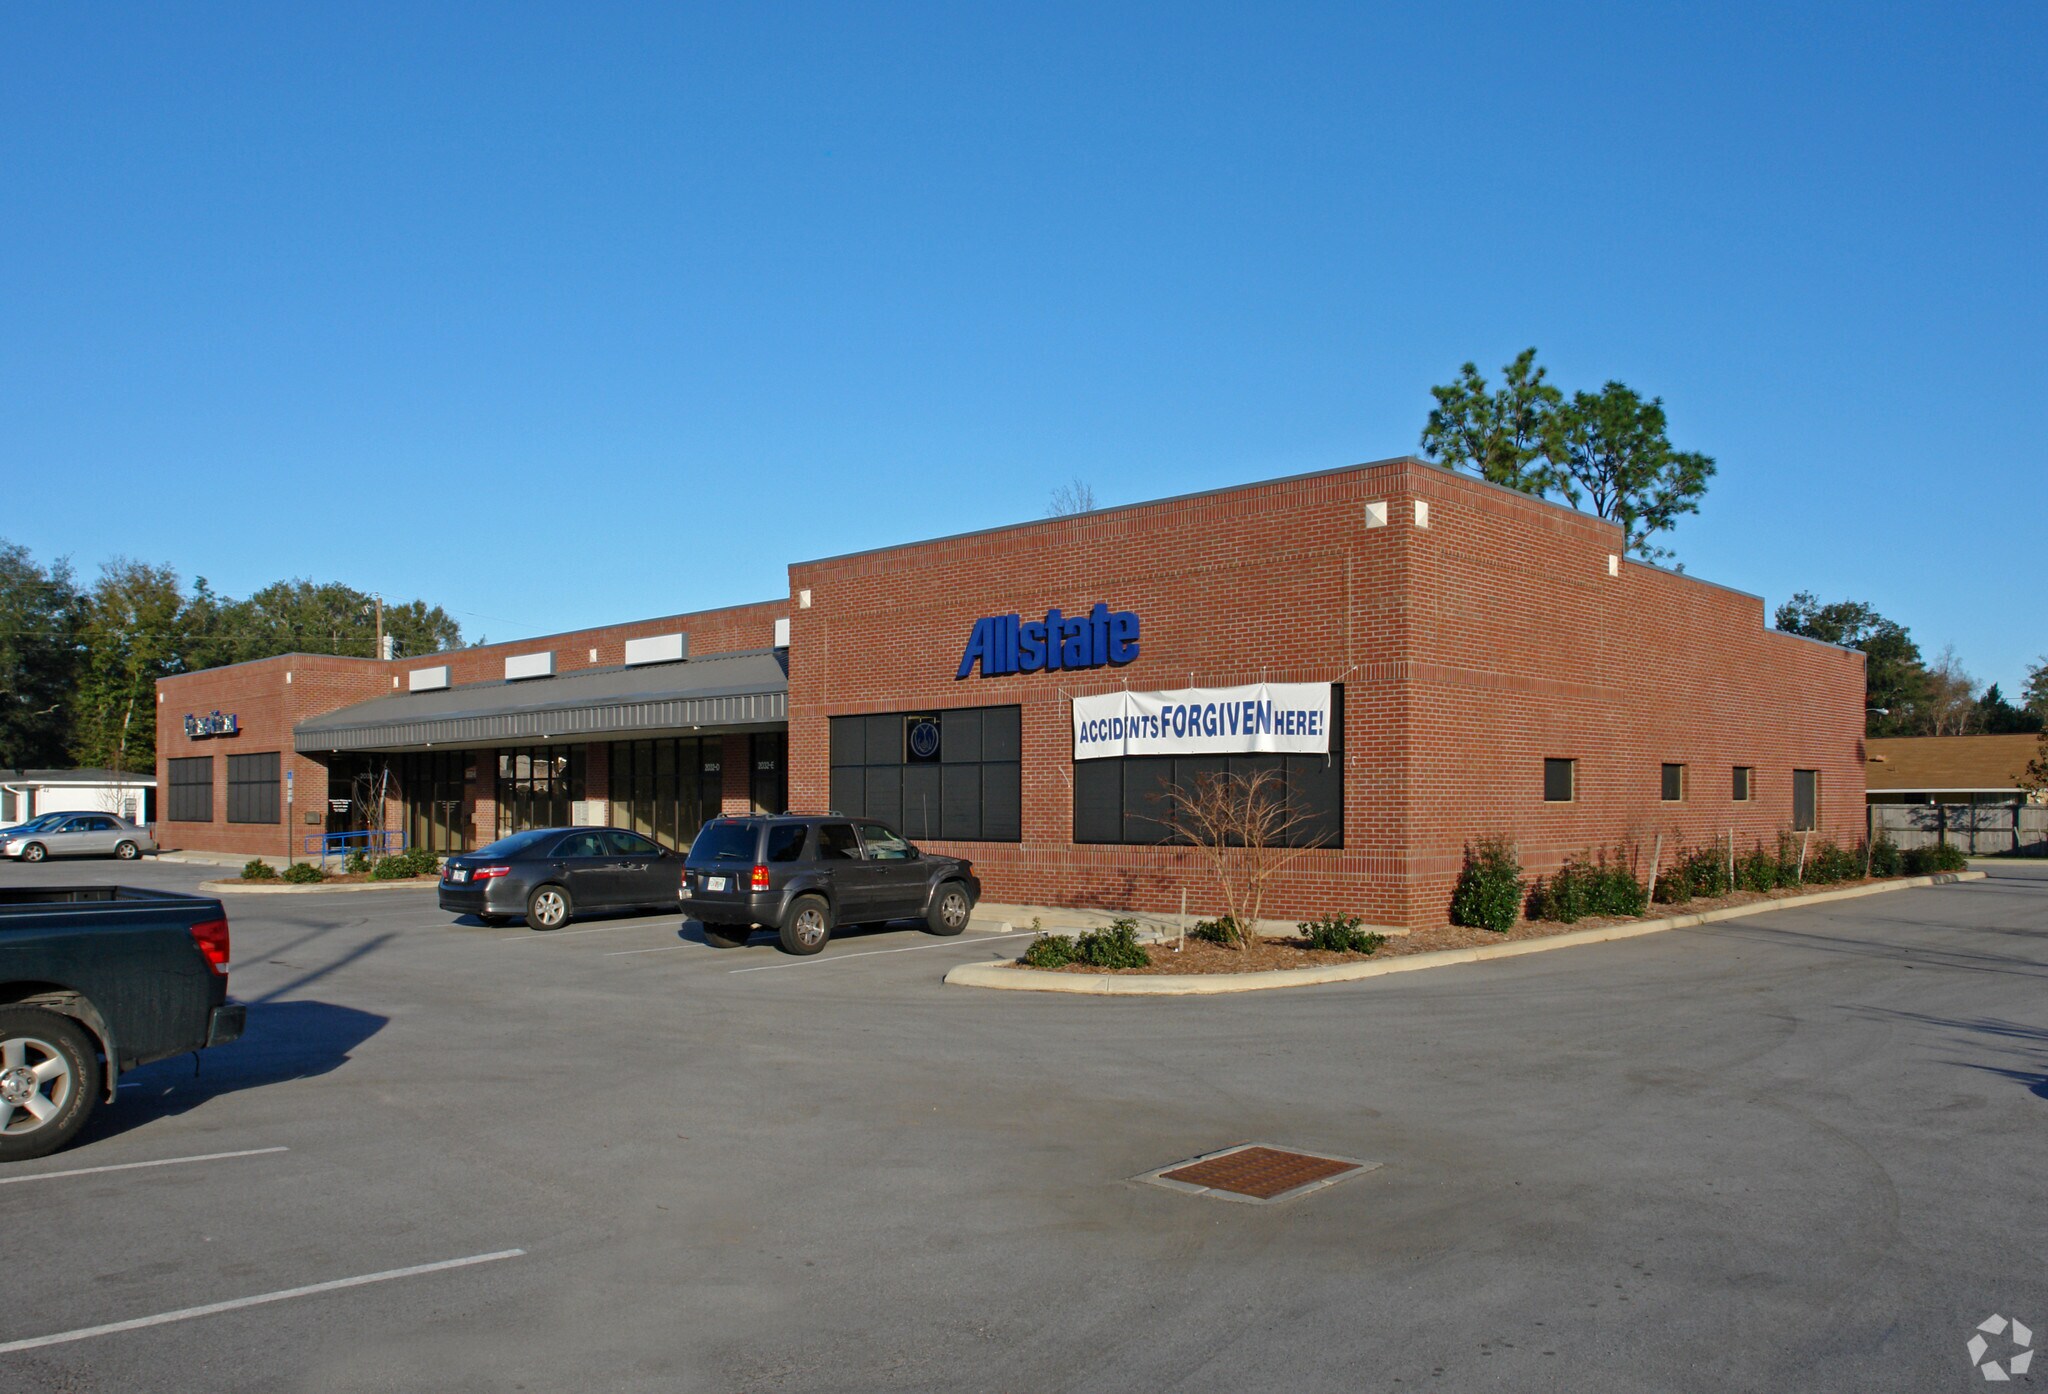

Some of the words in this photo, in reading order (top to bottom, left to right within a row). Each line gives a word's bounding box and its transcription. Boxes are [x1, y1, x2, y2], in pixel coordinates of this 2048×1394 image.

[956, 603, 1140, 679] Allstate
[1079, 715, 1159, 744] ACCIDENTS
[1160, 701, 1272, 739] FORGIVEN
[1274, 710, 1323, 736] HERE!
